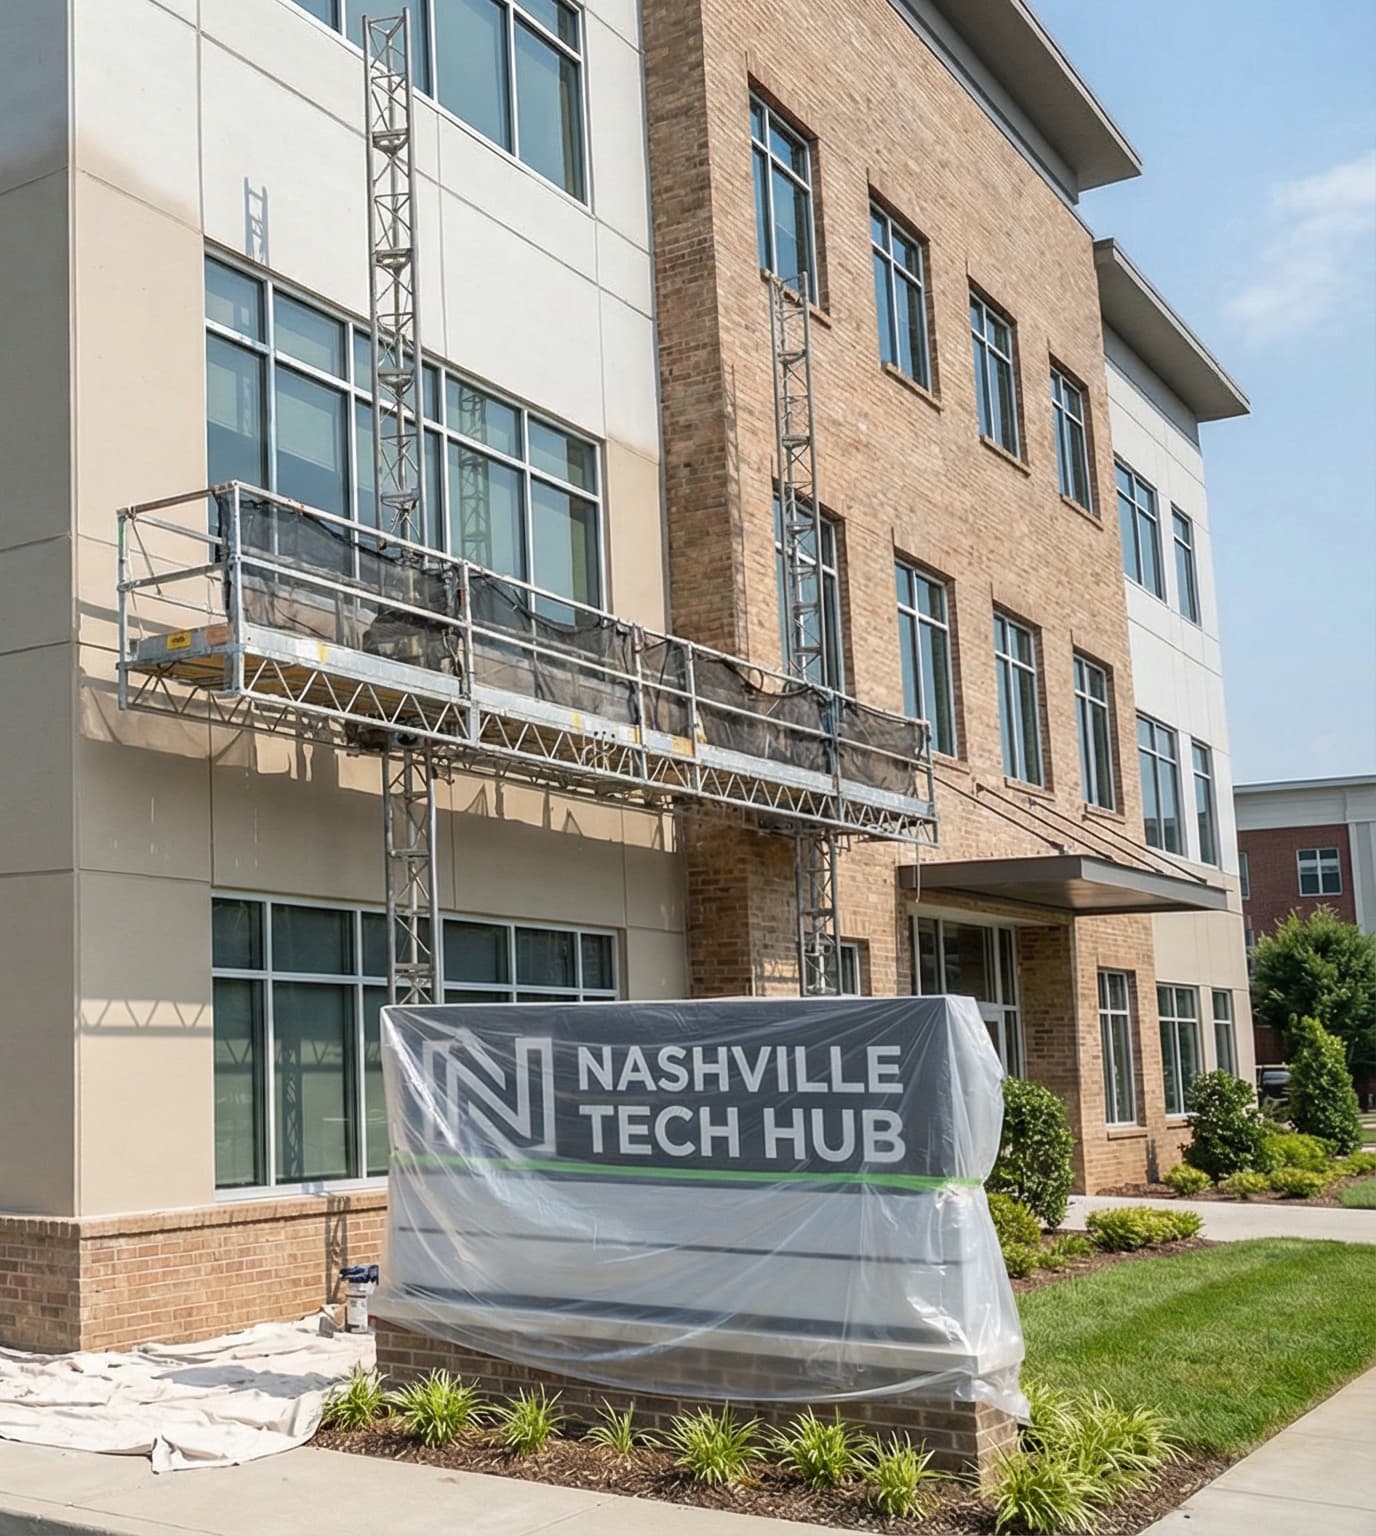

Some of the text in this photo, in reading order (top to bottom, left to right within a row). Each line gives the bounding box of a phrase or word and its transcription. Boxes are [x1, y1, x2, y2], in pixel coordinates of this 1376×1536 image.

[577, 1045, 904, 1093] NASHVILLE
[578, 1105, 906, 1163] TECH HUB
